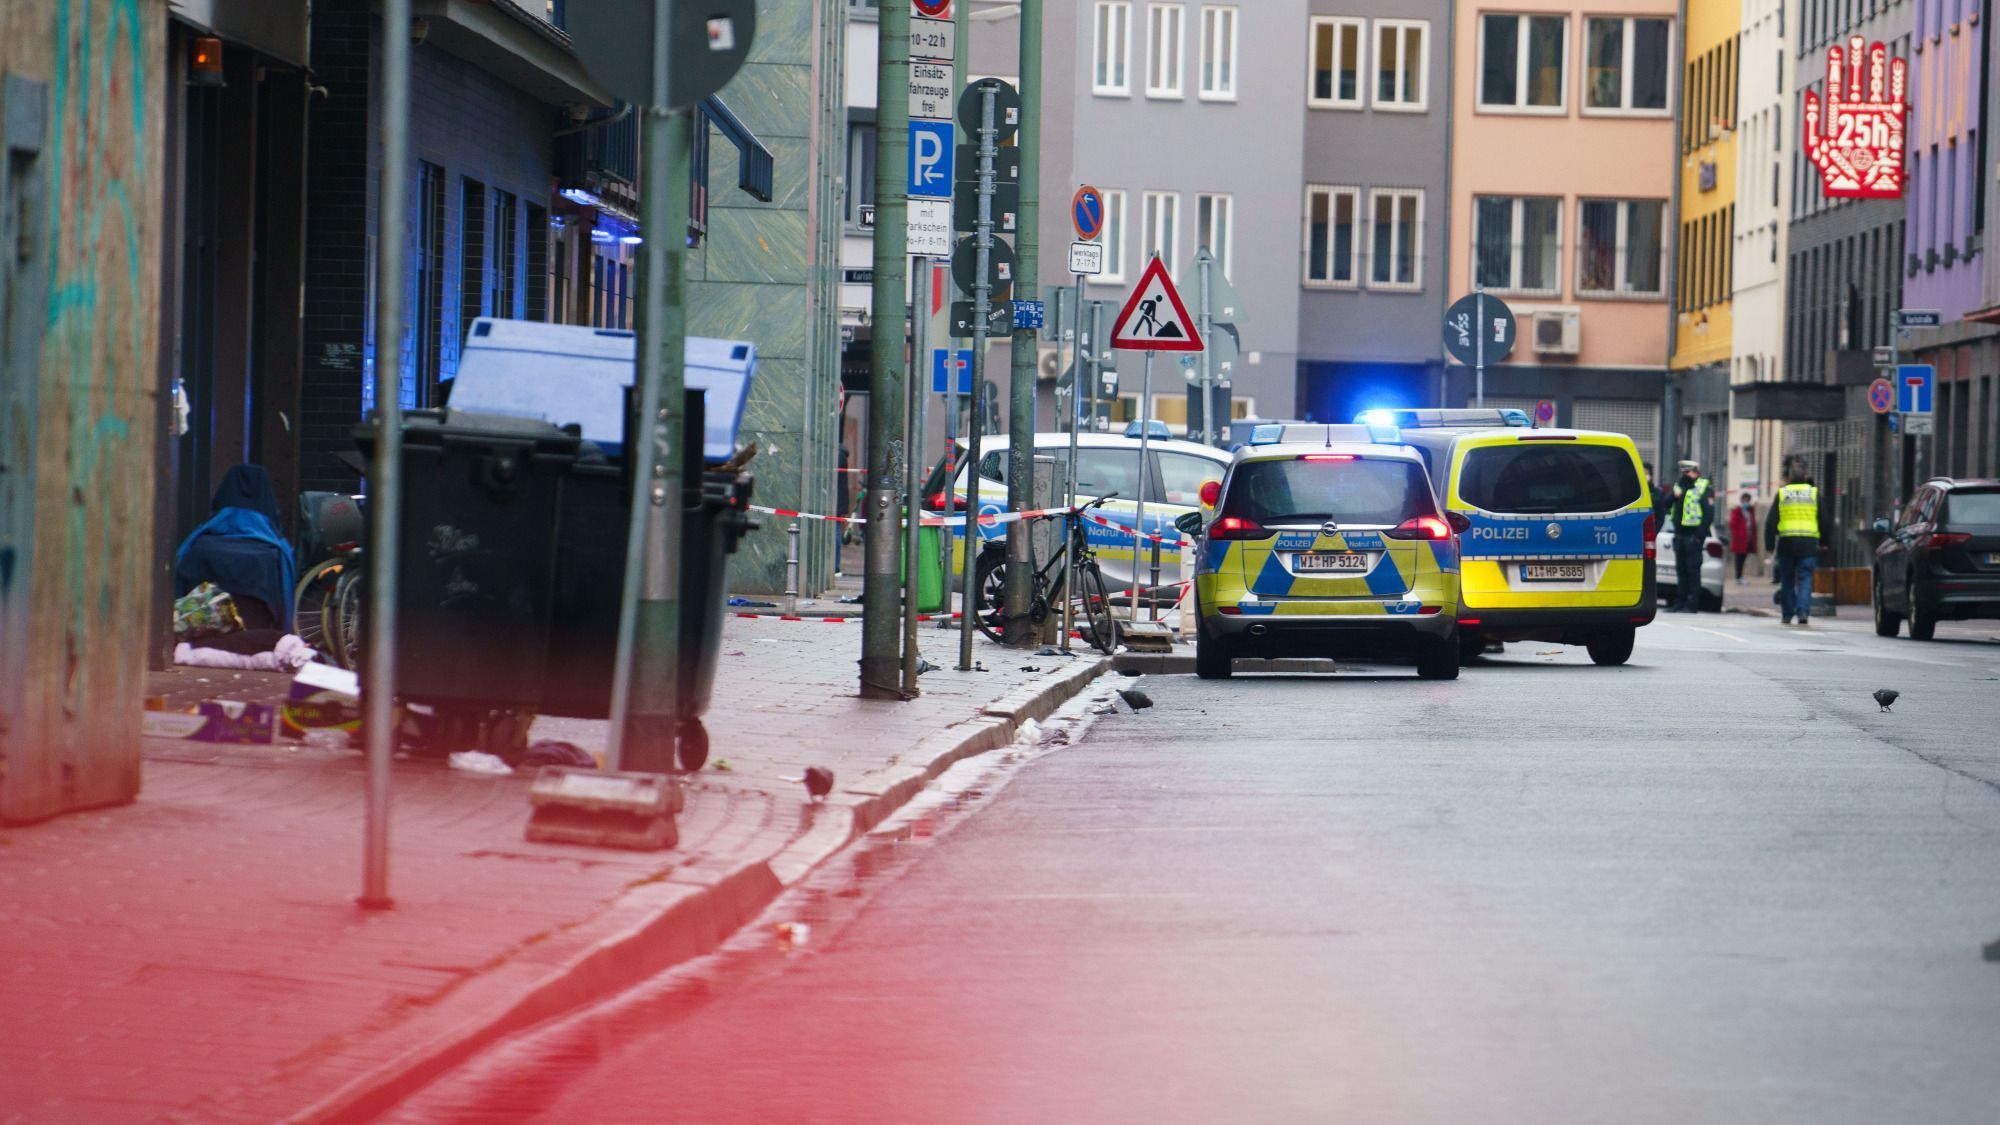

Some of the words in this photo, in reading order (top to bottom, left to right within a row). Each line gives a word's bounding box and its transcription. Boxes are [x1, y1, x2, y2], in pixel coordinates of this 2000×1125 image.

[928, 34, 938, 47] 22
[940, 32, 946, 48] h
[914, 65, 946, 79] Einsatz-
[909, 82, 949, 99] fahrzeuge
[922, 100, 936, 113] frei
[1838, 113, 1889, 148] 25h
[920, 209, 934, 218] mit
[906, 222, 948, 233] arkschein
[906, 236, 926, 246] o-Fr
[1472, 527, 1529, 540] POLIZEI
[1594, 532, 1617, 545] 110
[1277, 539, 1311, 548] POLIZEI
[1371, 539, 1383, 547] 110
[1322, 556, 1337, 568] HP
[1338, 556, 1366, 568] 5124
[1545, 566, 1558, 577] HP
